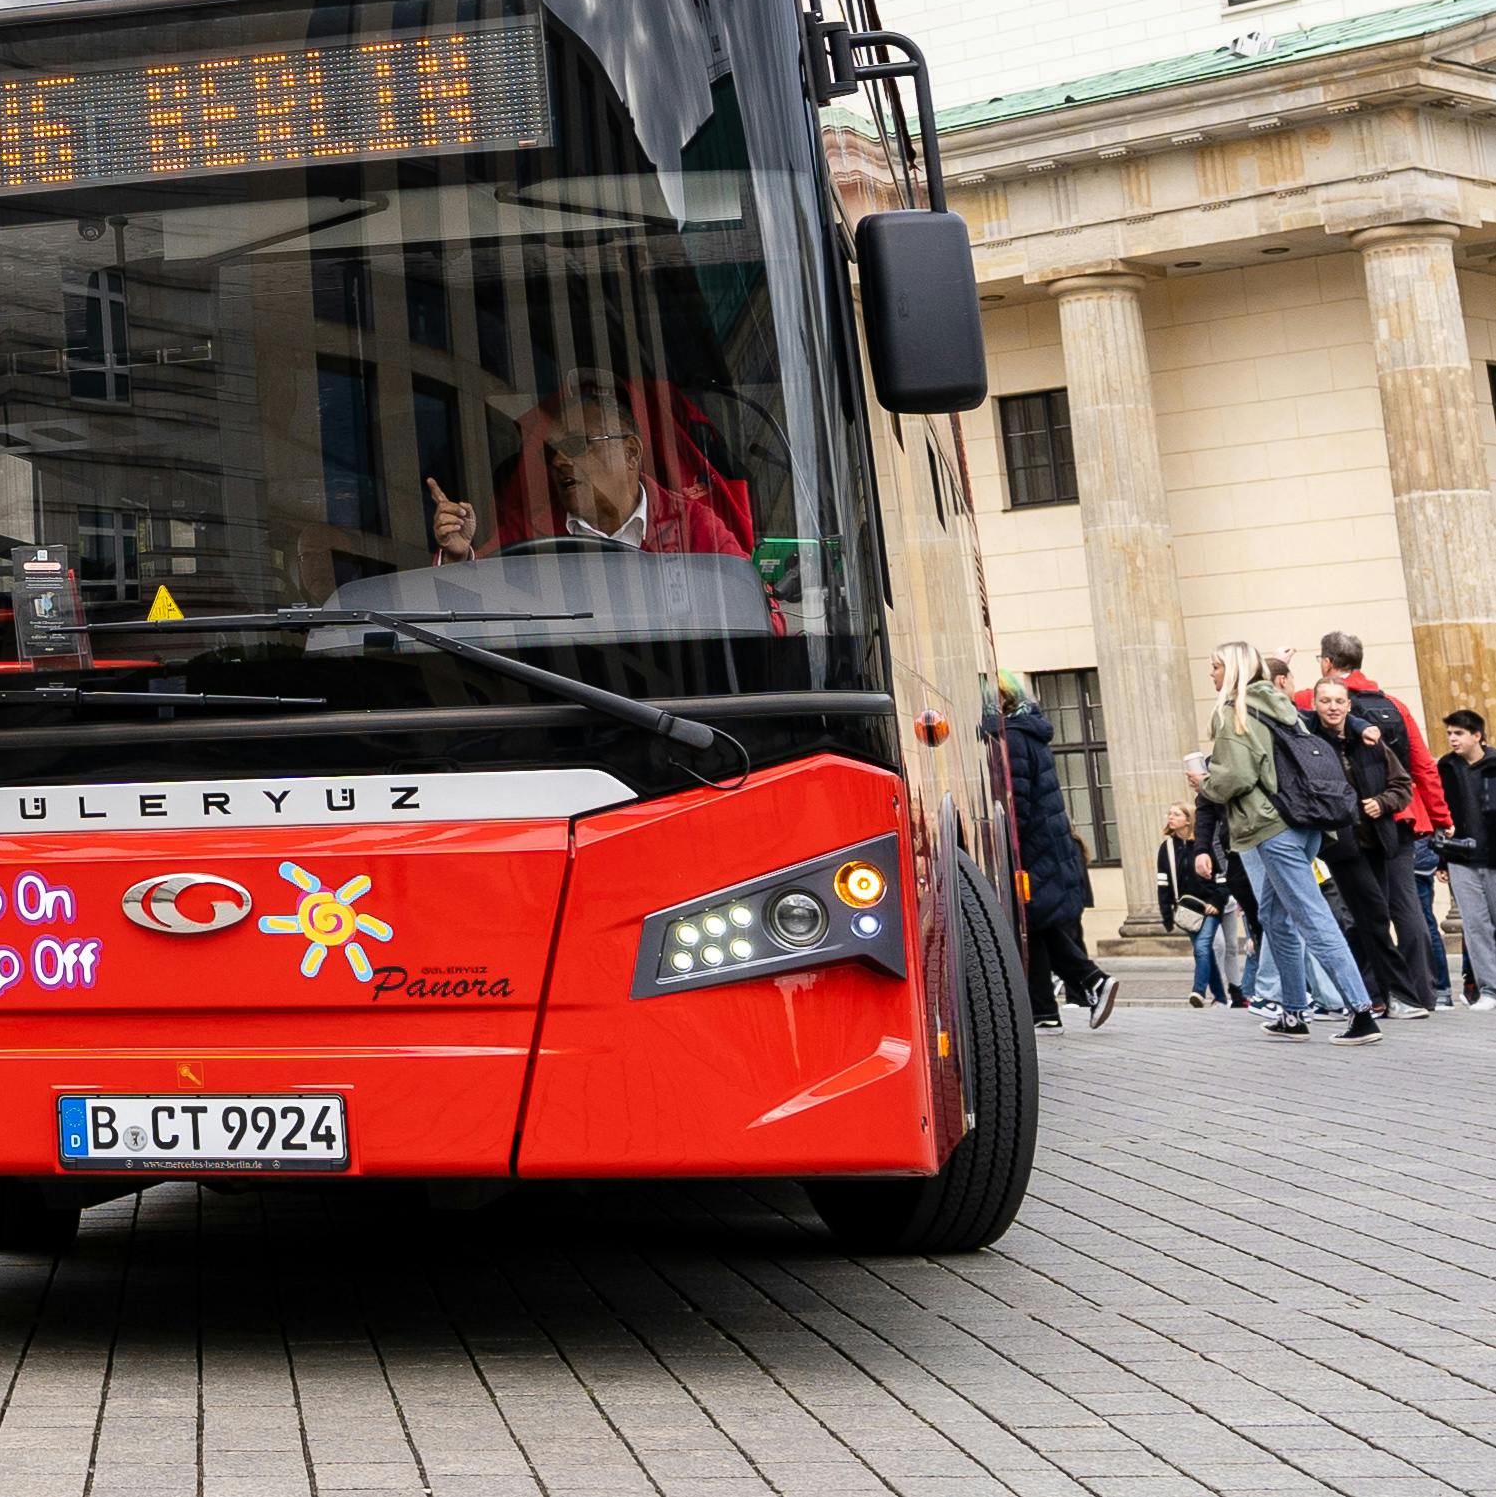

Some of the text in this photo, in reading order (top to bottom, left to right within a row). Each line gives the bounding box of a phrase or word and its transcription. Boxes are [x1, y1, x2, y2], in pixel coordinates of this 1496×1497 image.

[146, 34, 474, 173] BERLIN
[16, 874, 74, 921] On
[33, 937, 101, 987] Off
[372, 965, 515, 1002] Panora
[71, 1134, 81, 1149] D
[91, 1106, 337, 1151] B CT 9924
